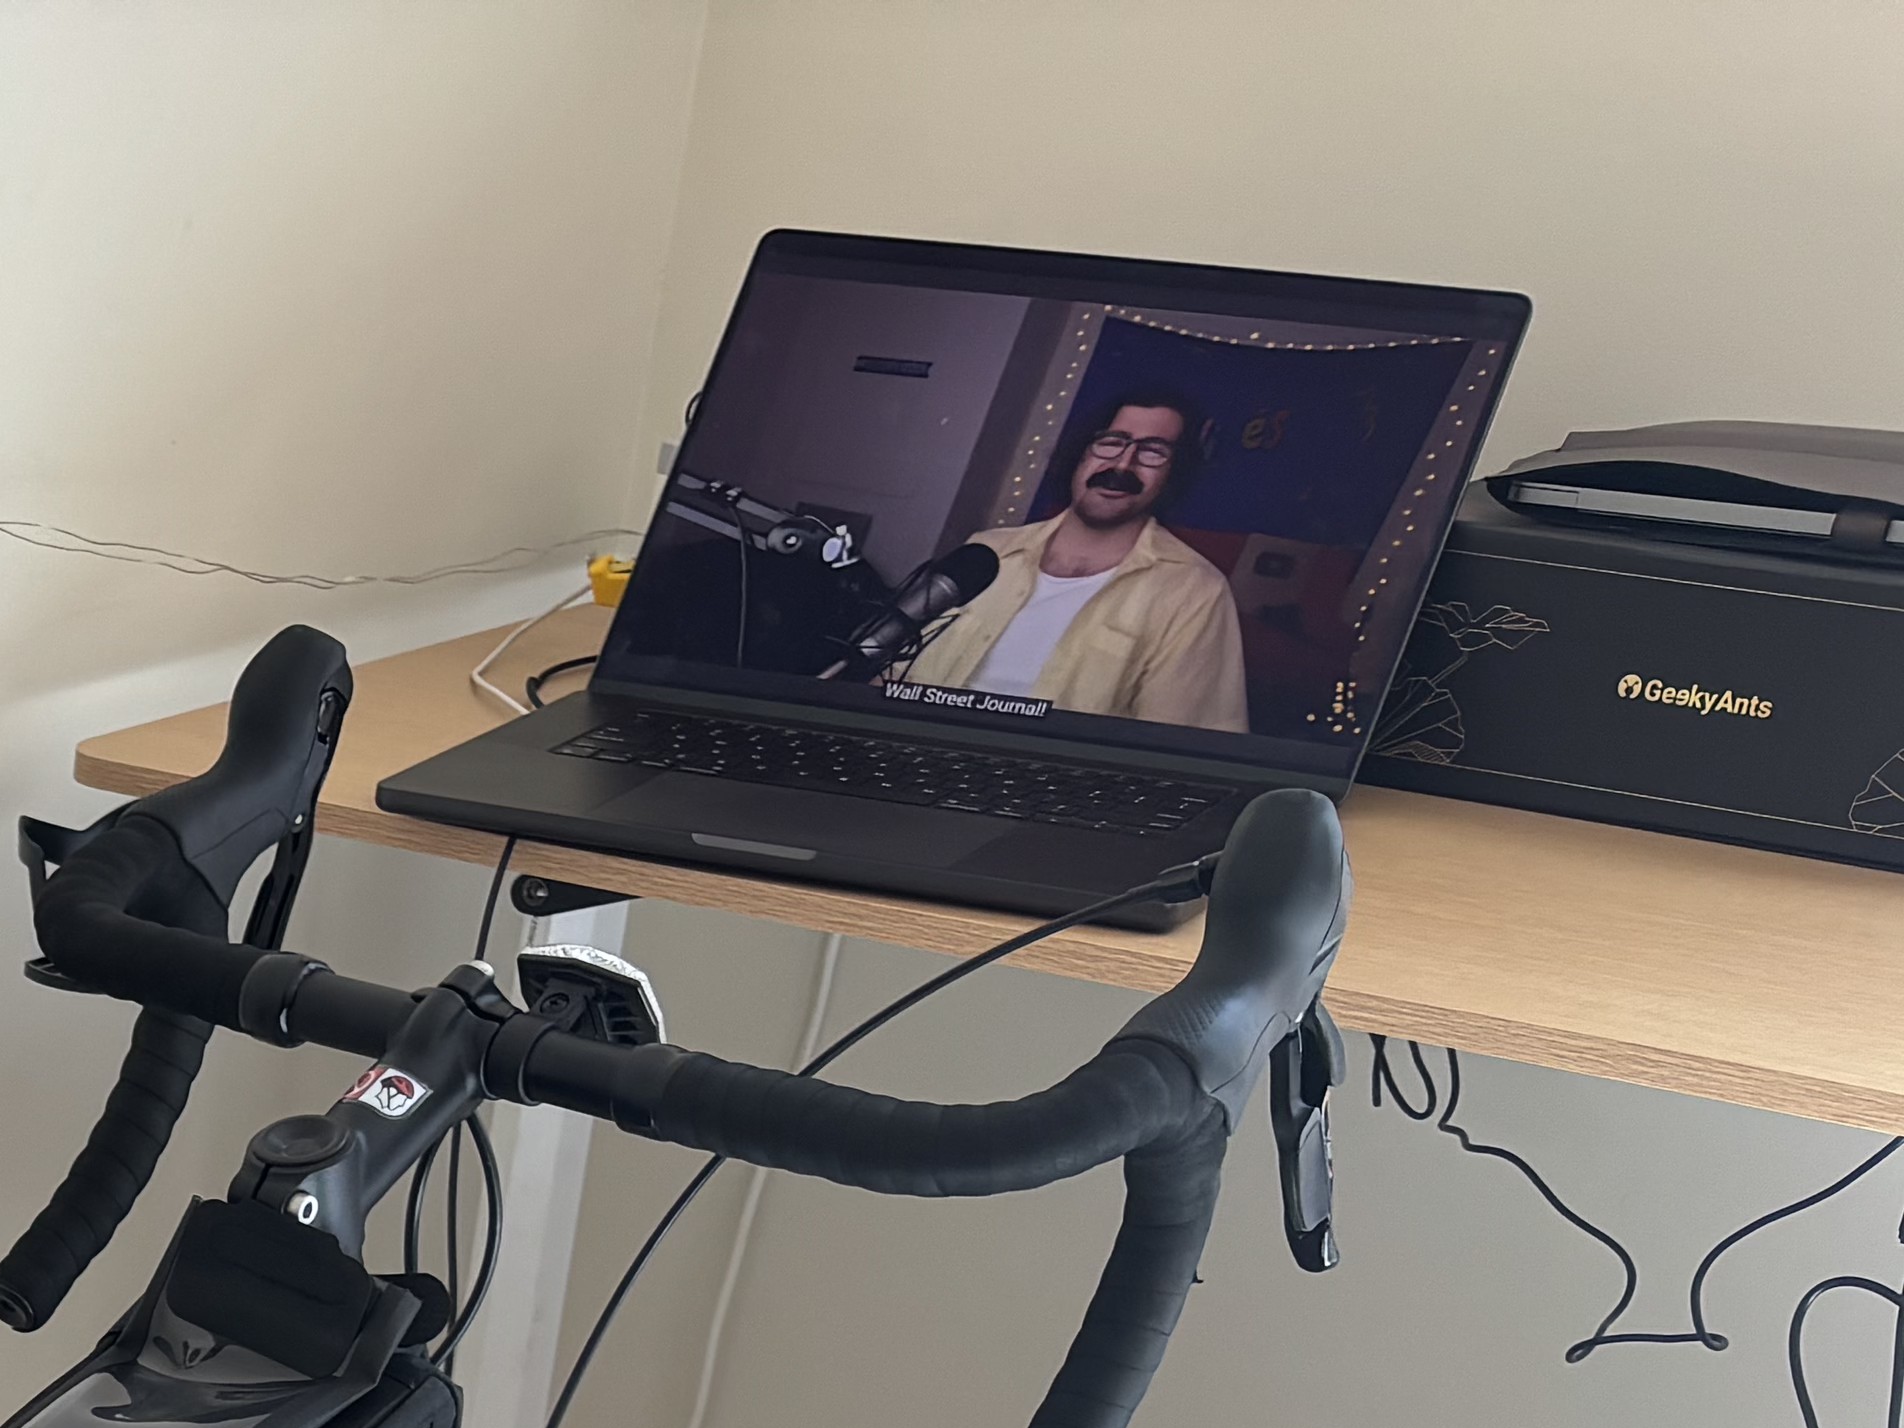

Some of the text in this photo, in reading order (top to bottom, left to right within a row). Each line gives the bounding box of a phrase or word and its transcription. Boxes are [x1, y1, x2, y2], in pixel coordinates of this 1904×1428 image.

[885, 682, 1048, 717] Wall Street Journal!
[1644, 679, 1774, 718] GeekyAnts
